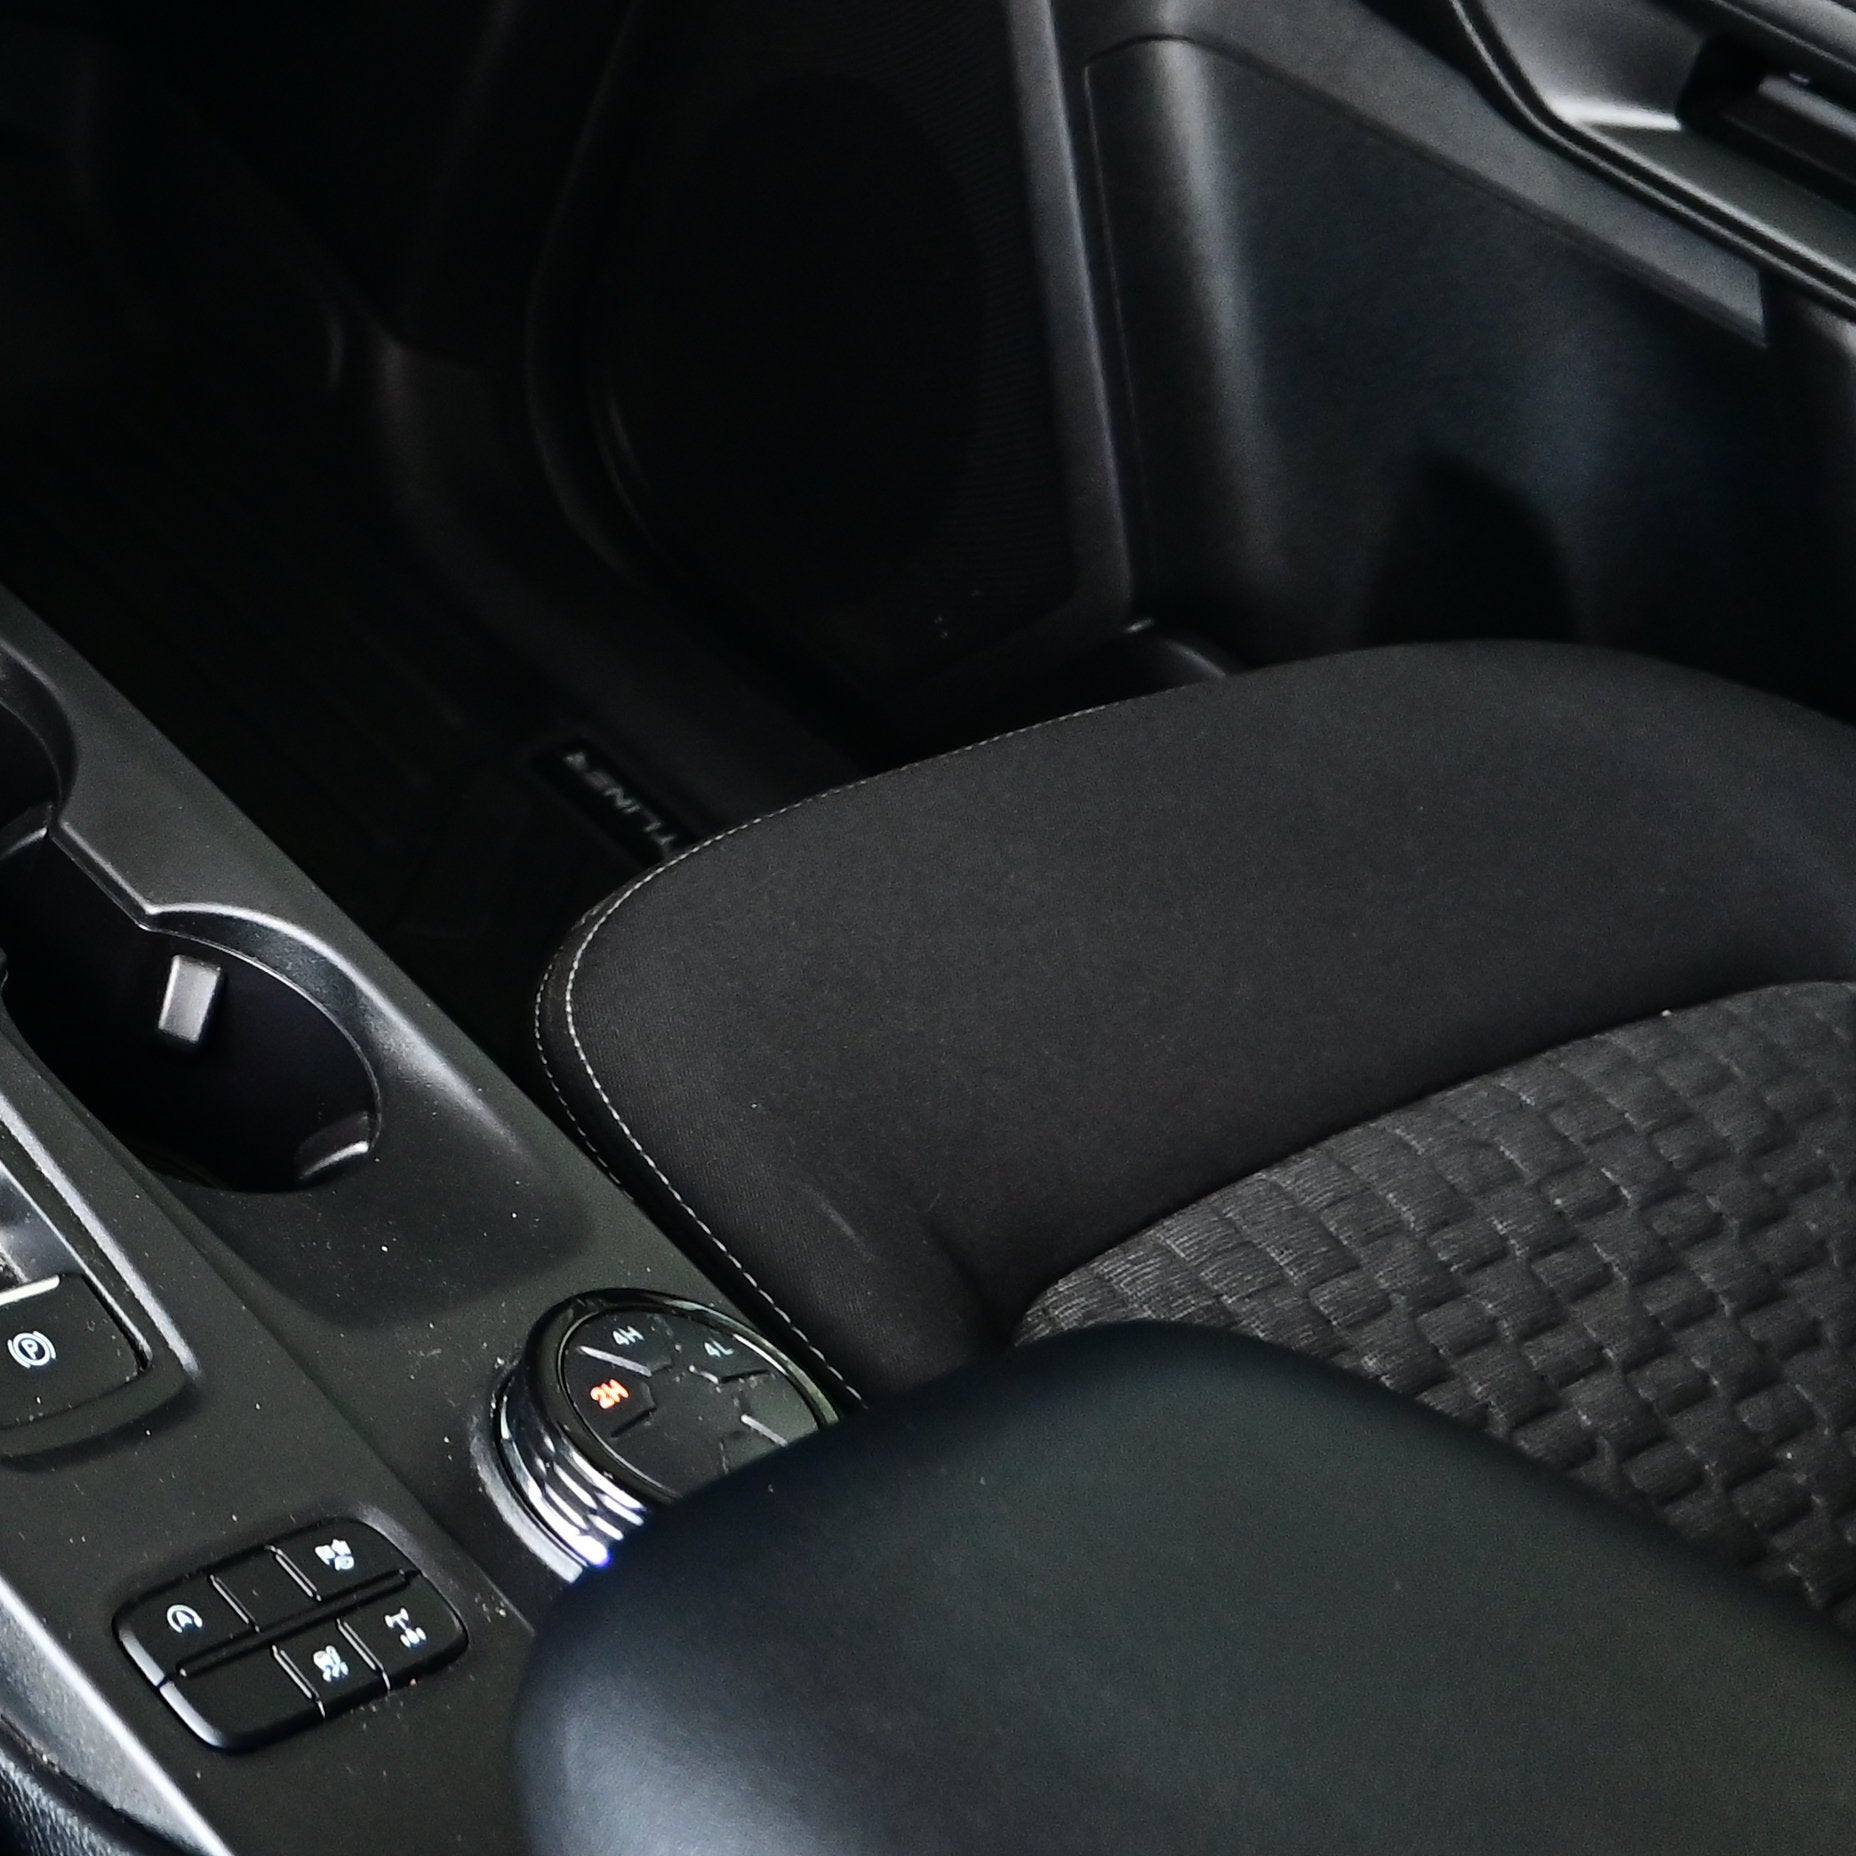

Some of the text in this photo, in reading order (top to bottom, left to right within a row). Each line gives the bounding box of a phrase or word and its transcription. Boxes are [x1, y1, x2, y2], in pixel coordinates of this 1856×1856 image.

[611, 1326, 645, 1347] 4H
[703, 1340, 734, 1359] 4L
[590, 1378, 630, 1410] 2H
